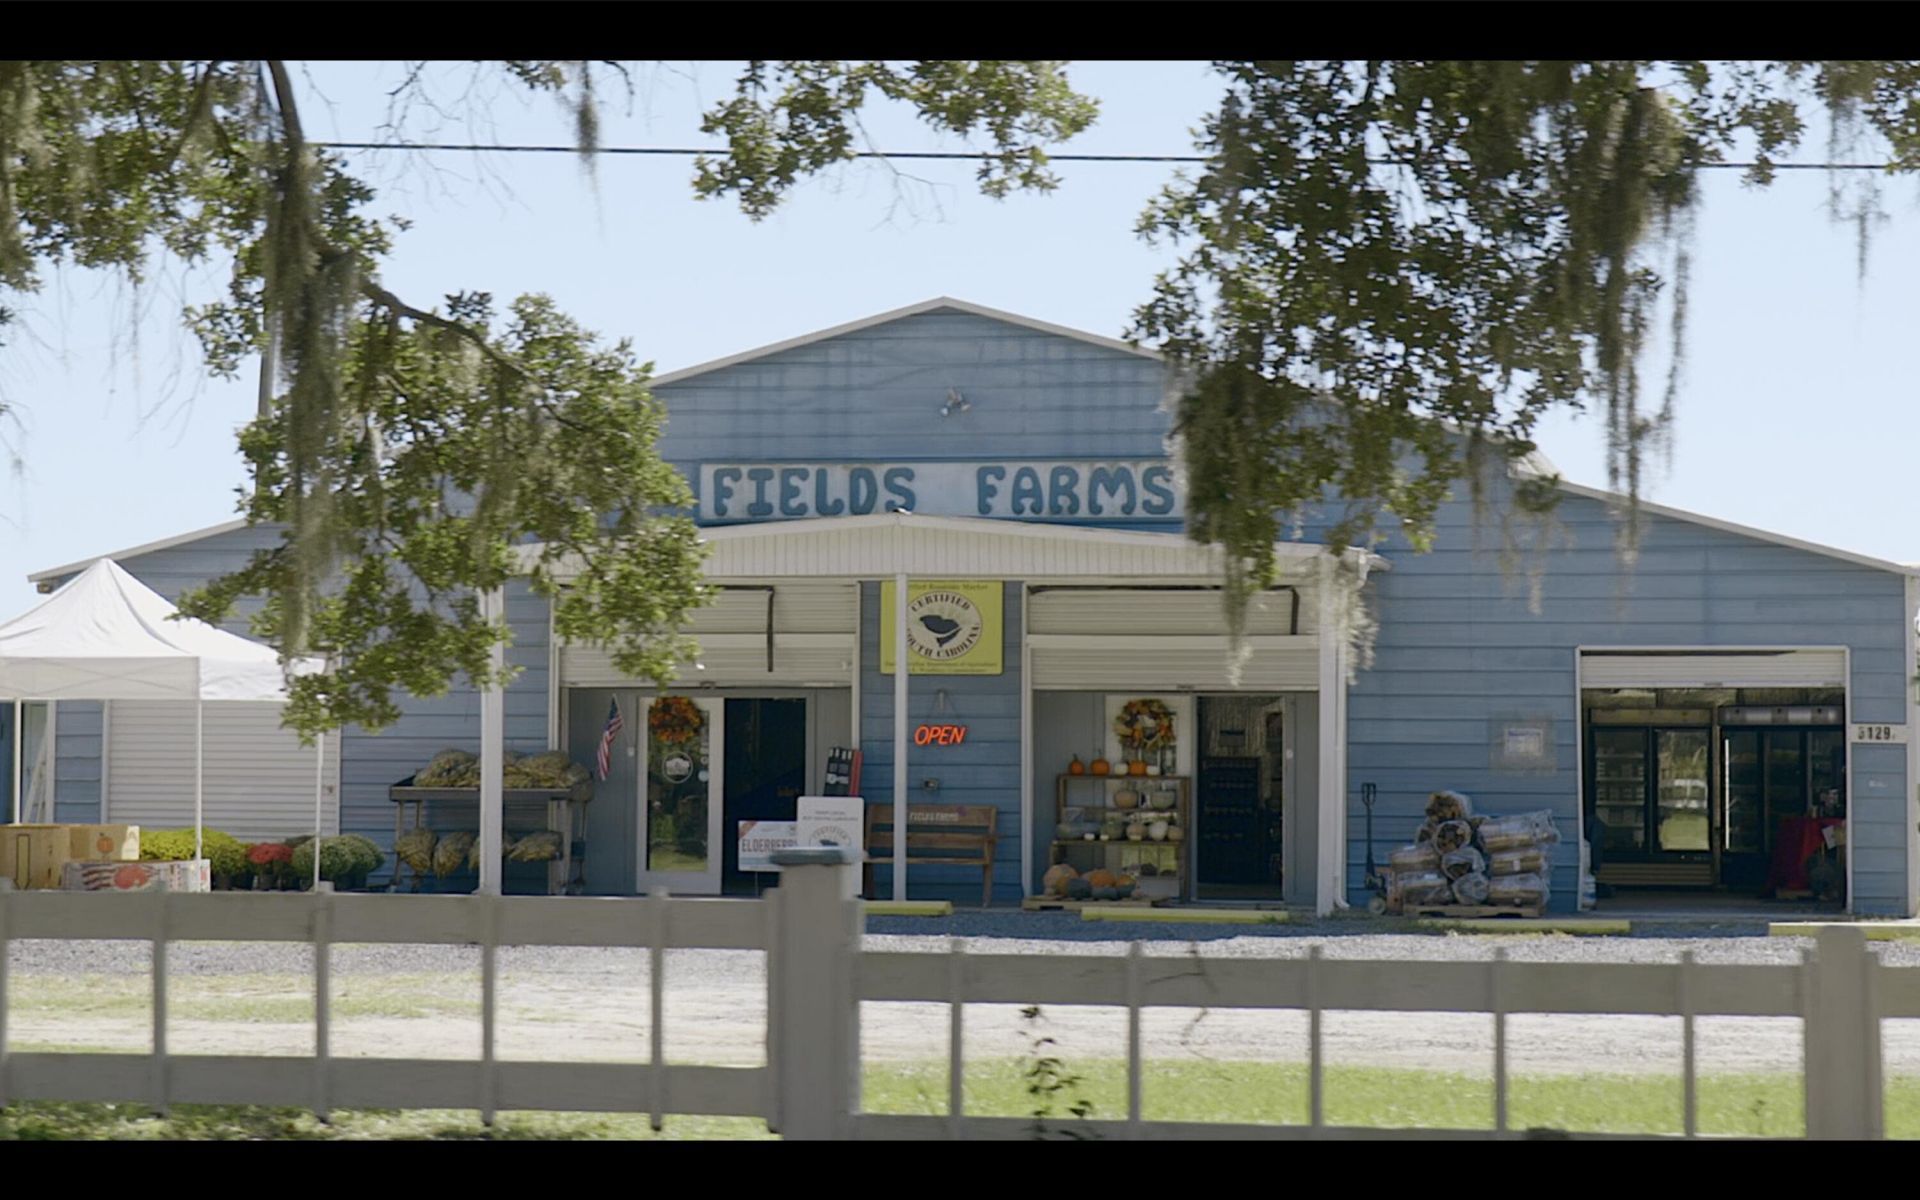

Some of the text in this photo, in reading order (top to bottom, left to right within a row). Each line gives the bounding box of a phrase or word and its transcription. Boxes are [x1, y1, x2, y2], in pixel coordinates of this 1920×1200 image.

[713, 466, 1175, 515] FIELDS FARMS
[911, 593, 970, 612] CERTIFIED
[936, 623, 980, 658] CAROLINA
[914, 724, 967, 745] OPEN
